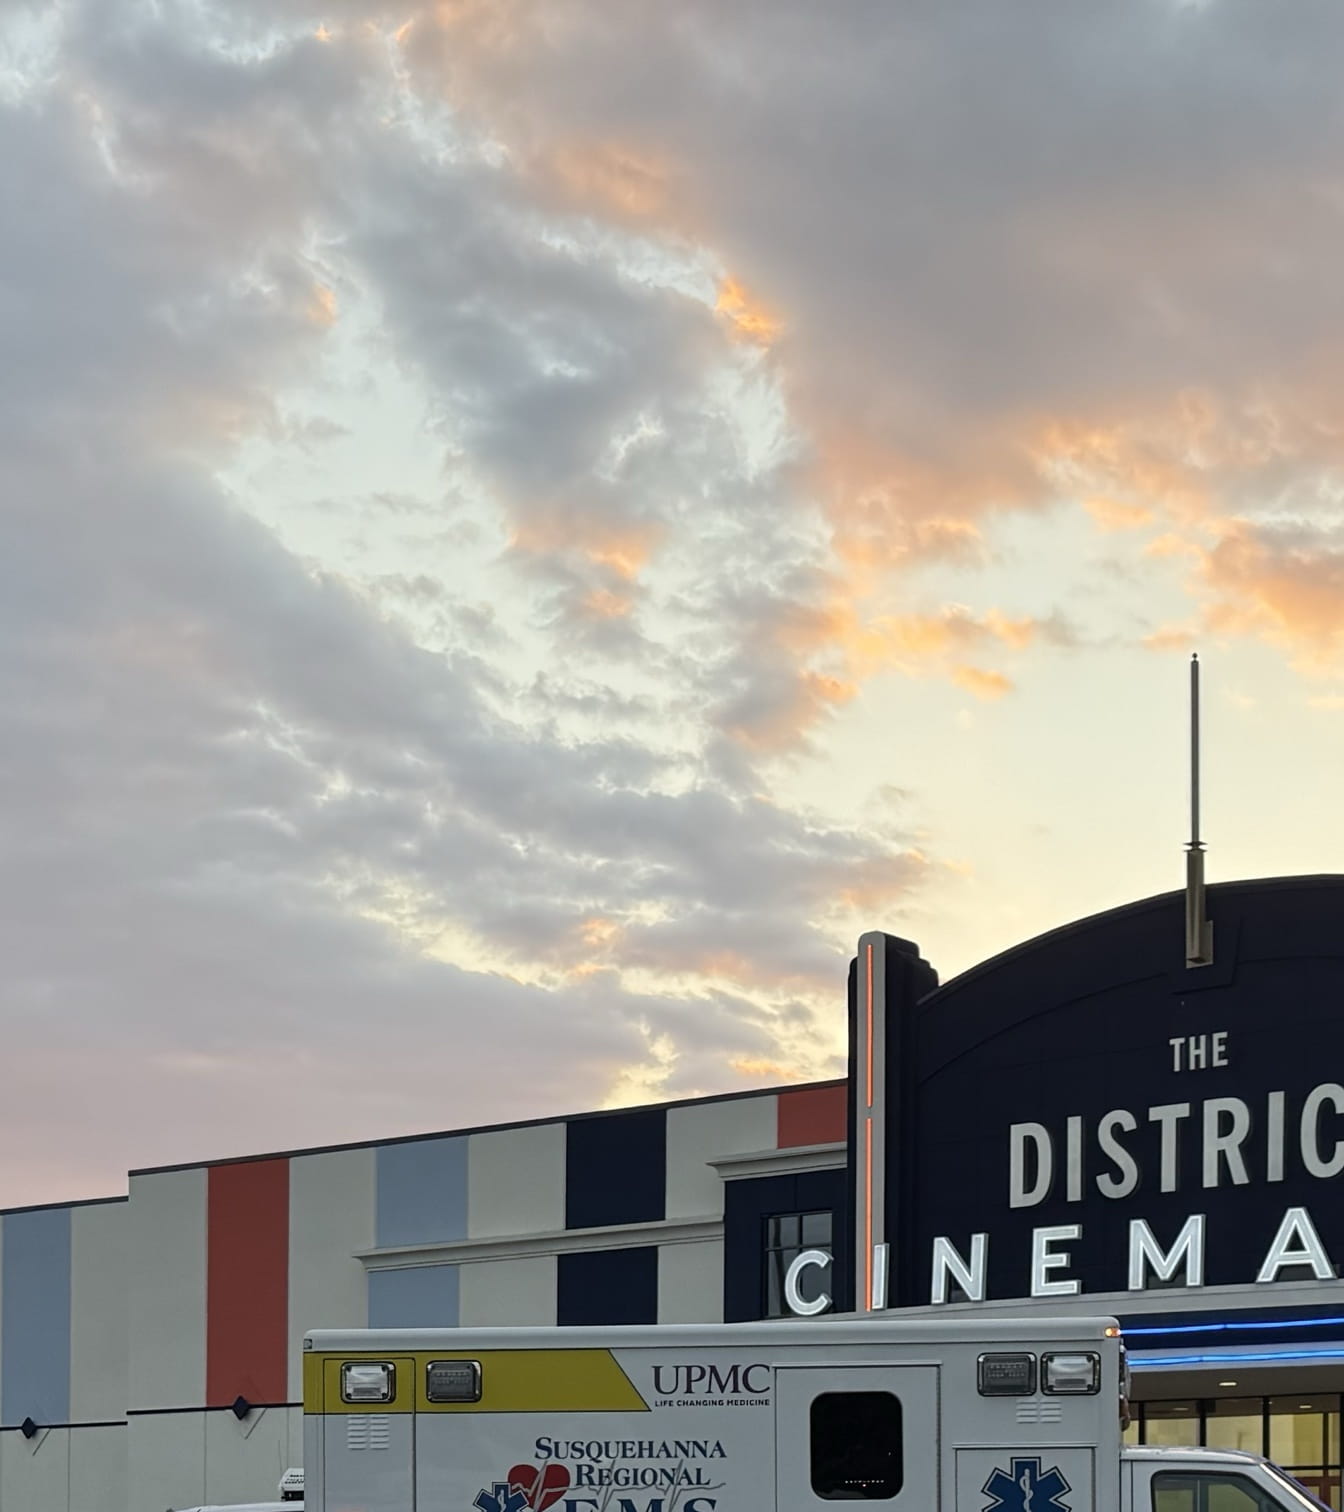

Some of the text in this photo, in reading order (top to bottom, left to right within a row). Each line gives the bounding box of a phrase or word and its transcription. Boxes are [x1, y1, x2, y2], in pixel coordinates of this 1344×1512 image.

[1169, 1030, 1229, 1073] THE
[783, 1206, 1338, 1316] CINEMA
[651, 1363, 771, 1395] UPMC
[655, 1399, 771, 1408] LIFE CHANGING MEDICINE
[533, 1436, 727, 1464] SUSQUEHANNA
[575, 1463, 711, 1488] REGIONAL
